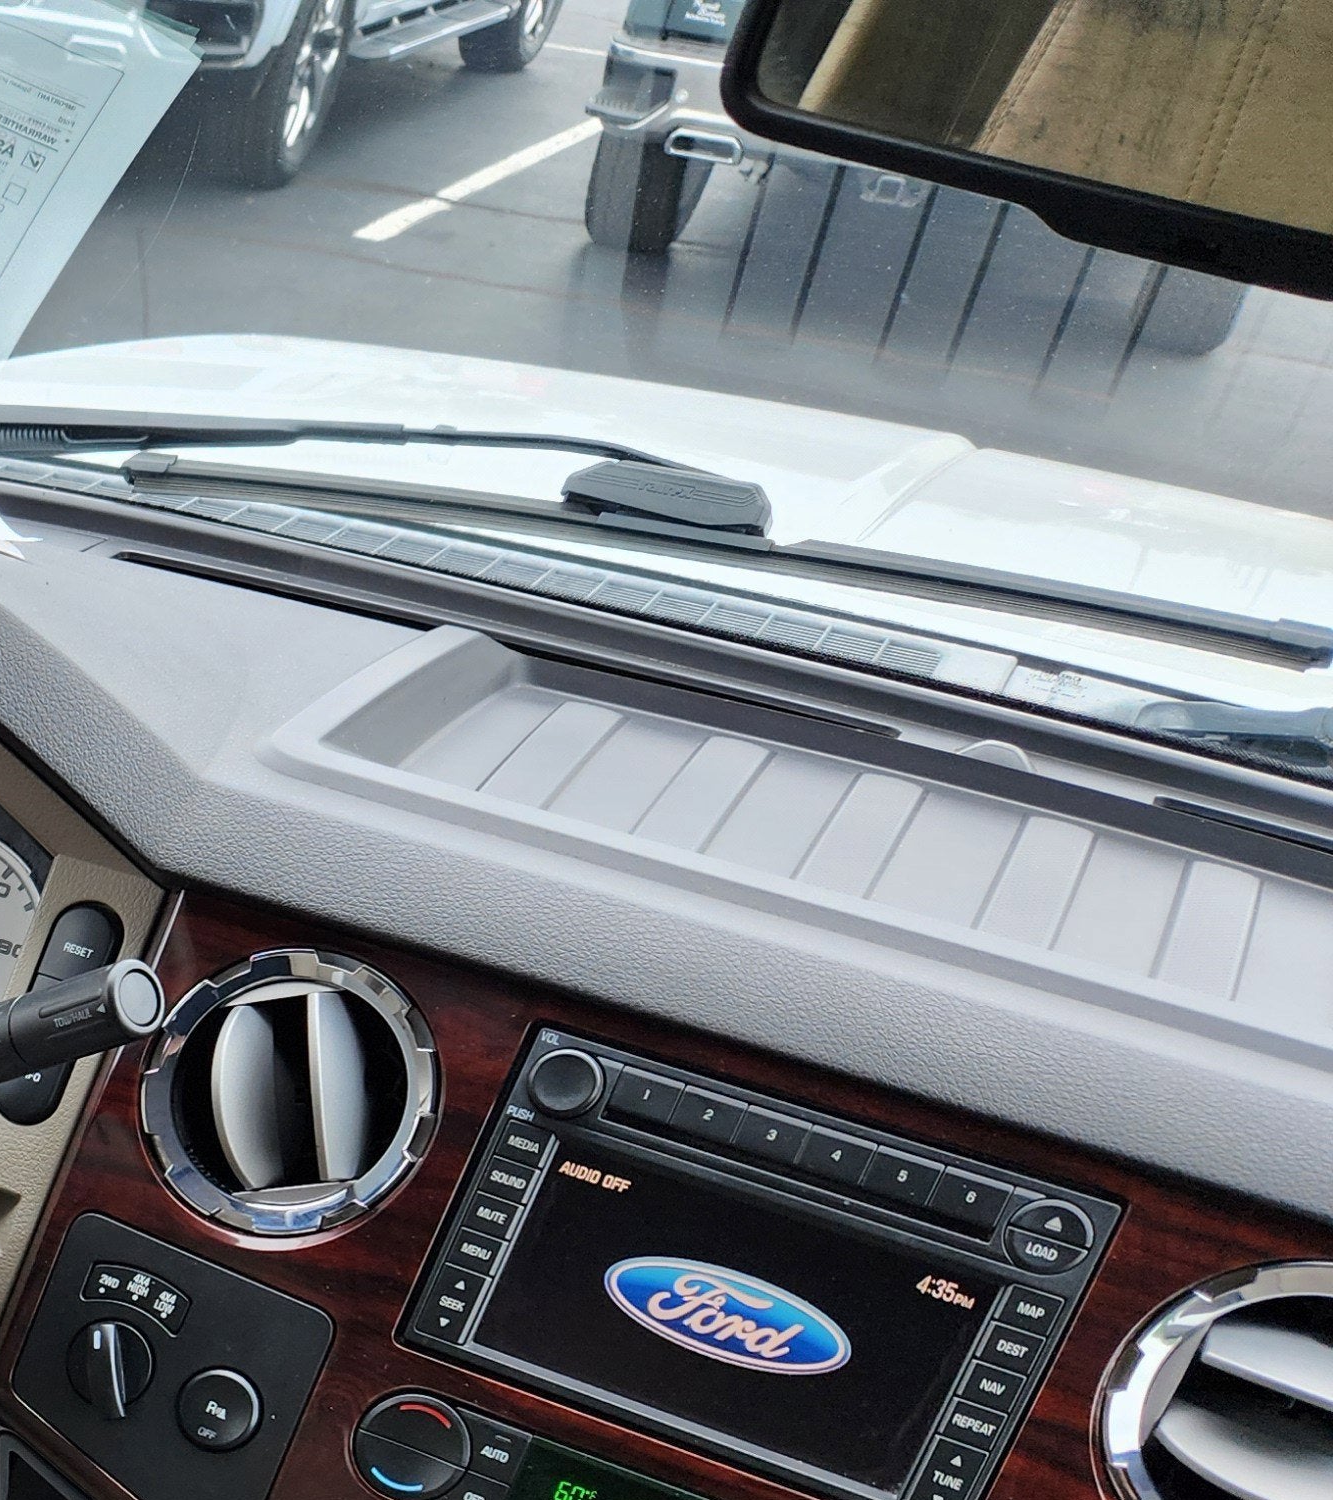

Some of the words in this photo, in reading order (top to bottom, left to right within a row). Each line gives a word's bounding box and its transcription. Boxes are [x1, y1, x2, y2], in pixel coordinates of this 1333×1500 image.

[63, 941, 94, 959] RESET
[540, 1031, 560, 1046] VOL
[643, 1088, 651, 1100] 1
[506, 1105, 534, 1122] PUSH
[702, 1108, 715, 1121] 2
[767, 1129, 778, 1141] 3
[507, 1135, 540, 1154] MEDIA
[830, 1149, 842, 1162] 4
[490, 1170, 527, 1190] SOUND
[558, 1161, 600, 1185] AUDIO
[601, 1174, 632, 1193] OFF
[896, 1169, 908, 1183] 5
[965, 1190, 976, 1204] 6
[476, 1206, 508, 1225] MUTE
[460, 1242, 493, 1261] MENU
[1025, 1243, 1058, 1262] LOAD
[99, 1273, 120, 1289] 2WD
[133, 1274, 151, 1287] 4X4
[127, 1281, 149, 1298] HIGH
[159, 1290, 177, 1305] 4X4
[153, 1300, 175, 1315] LOW
[438, 1295, 465, 1312] SEEK
[1016, 1301, 1045, 1319] MAP
[647, 1272, 803, 1362] Ford
[996, 1339, 1029, 1358] DEST
[979, 1378, 1006, 1396] NAV
[197, 1426, 217, 1440] OFF
[951, 1413, 996, 1437] REPEAT
[480, 1445, 510, 1464] AUTO
[933, 1470, 964, 1491] TUNE
